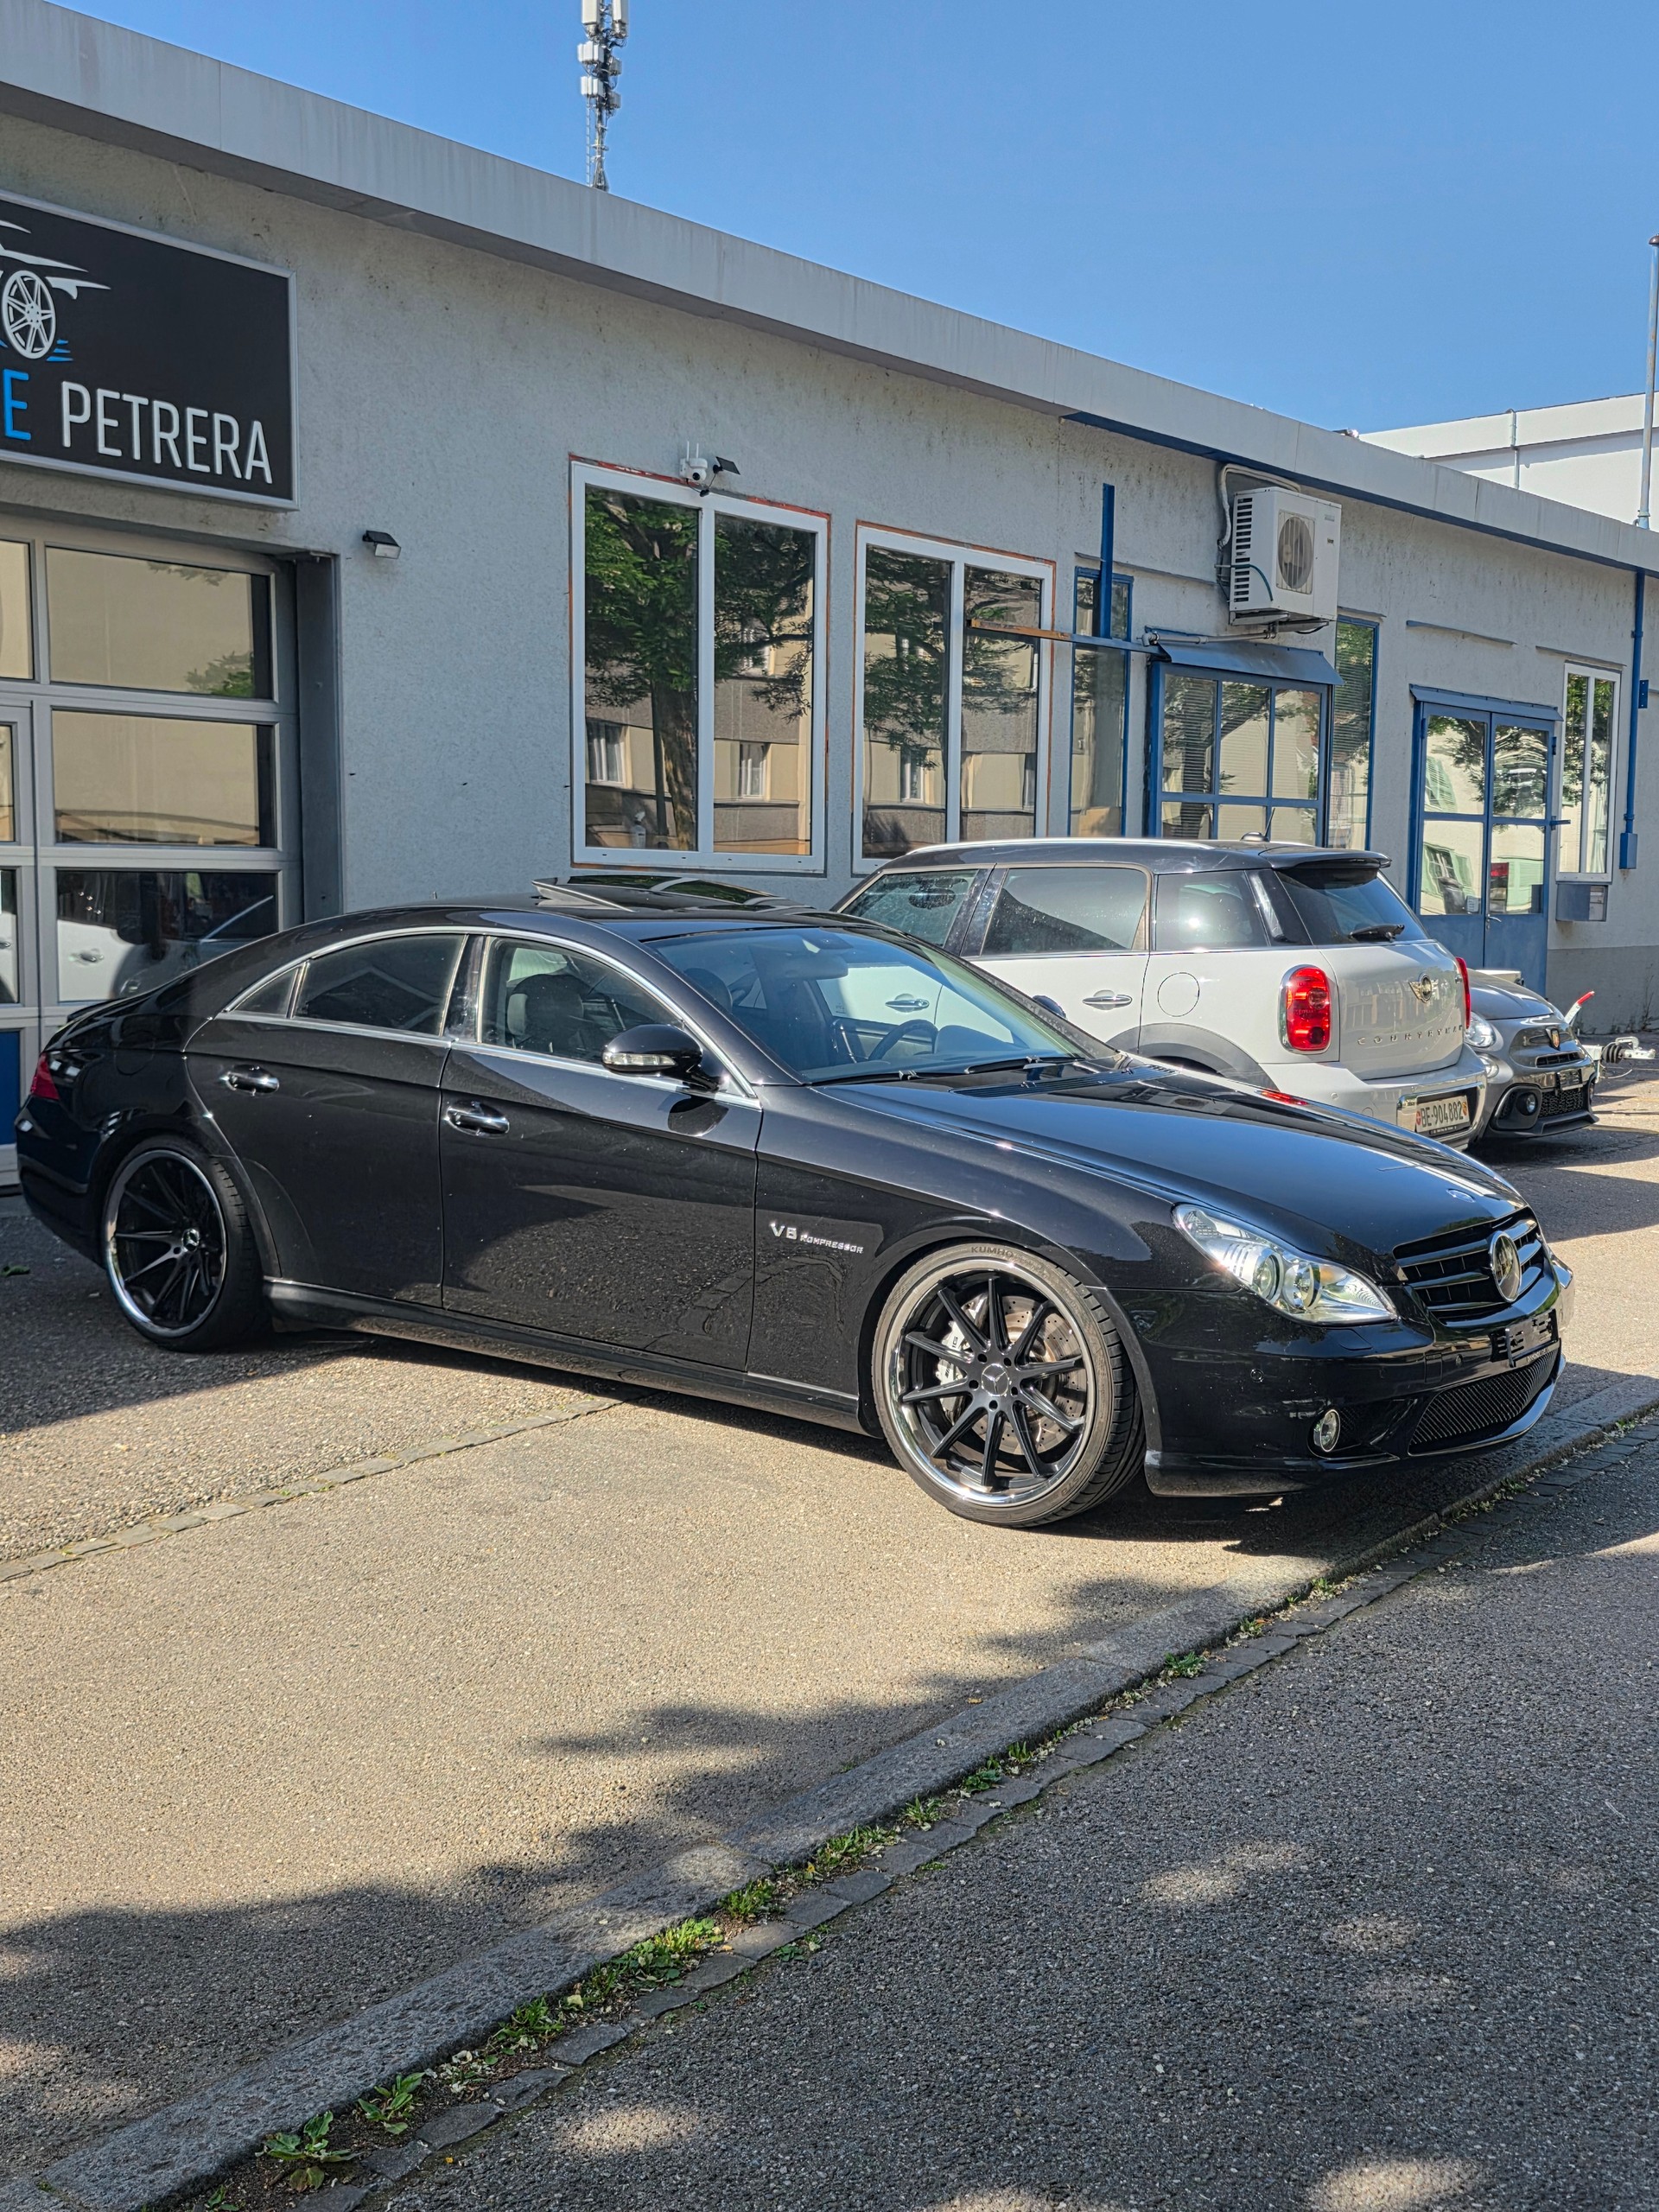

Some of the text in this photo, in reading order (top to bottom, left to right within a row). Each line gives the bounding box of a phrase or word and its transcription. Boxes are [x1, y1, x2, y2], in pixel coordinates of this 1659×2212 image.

[61, 380, 273, 485] PETRERA
[800, 1234, 864, 1254] KOMPRESSOR
[970, 1245, 1014, 1258] KUMHO
